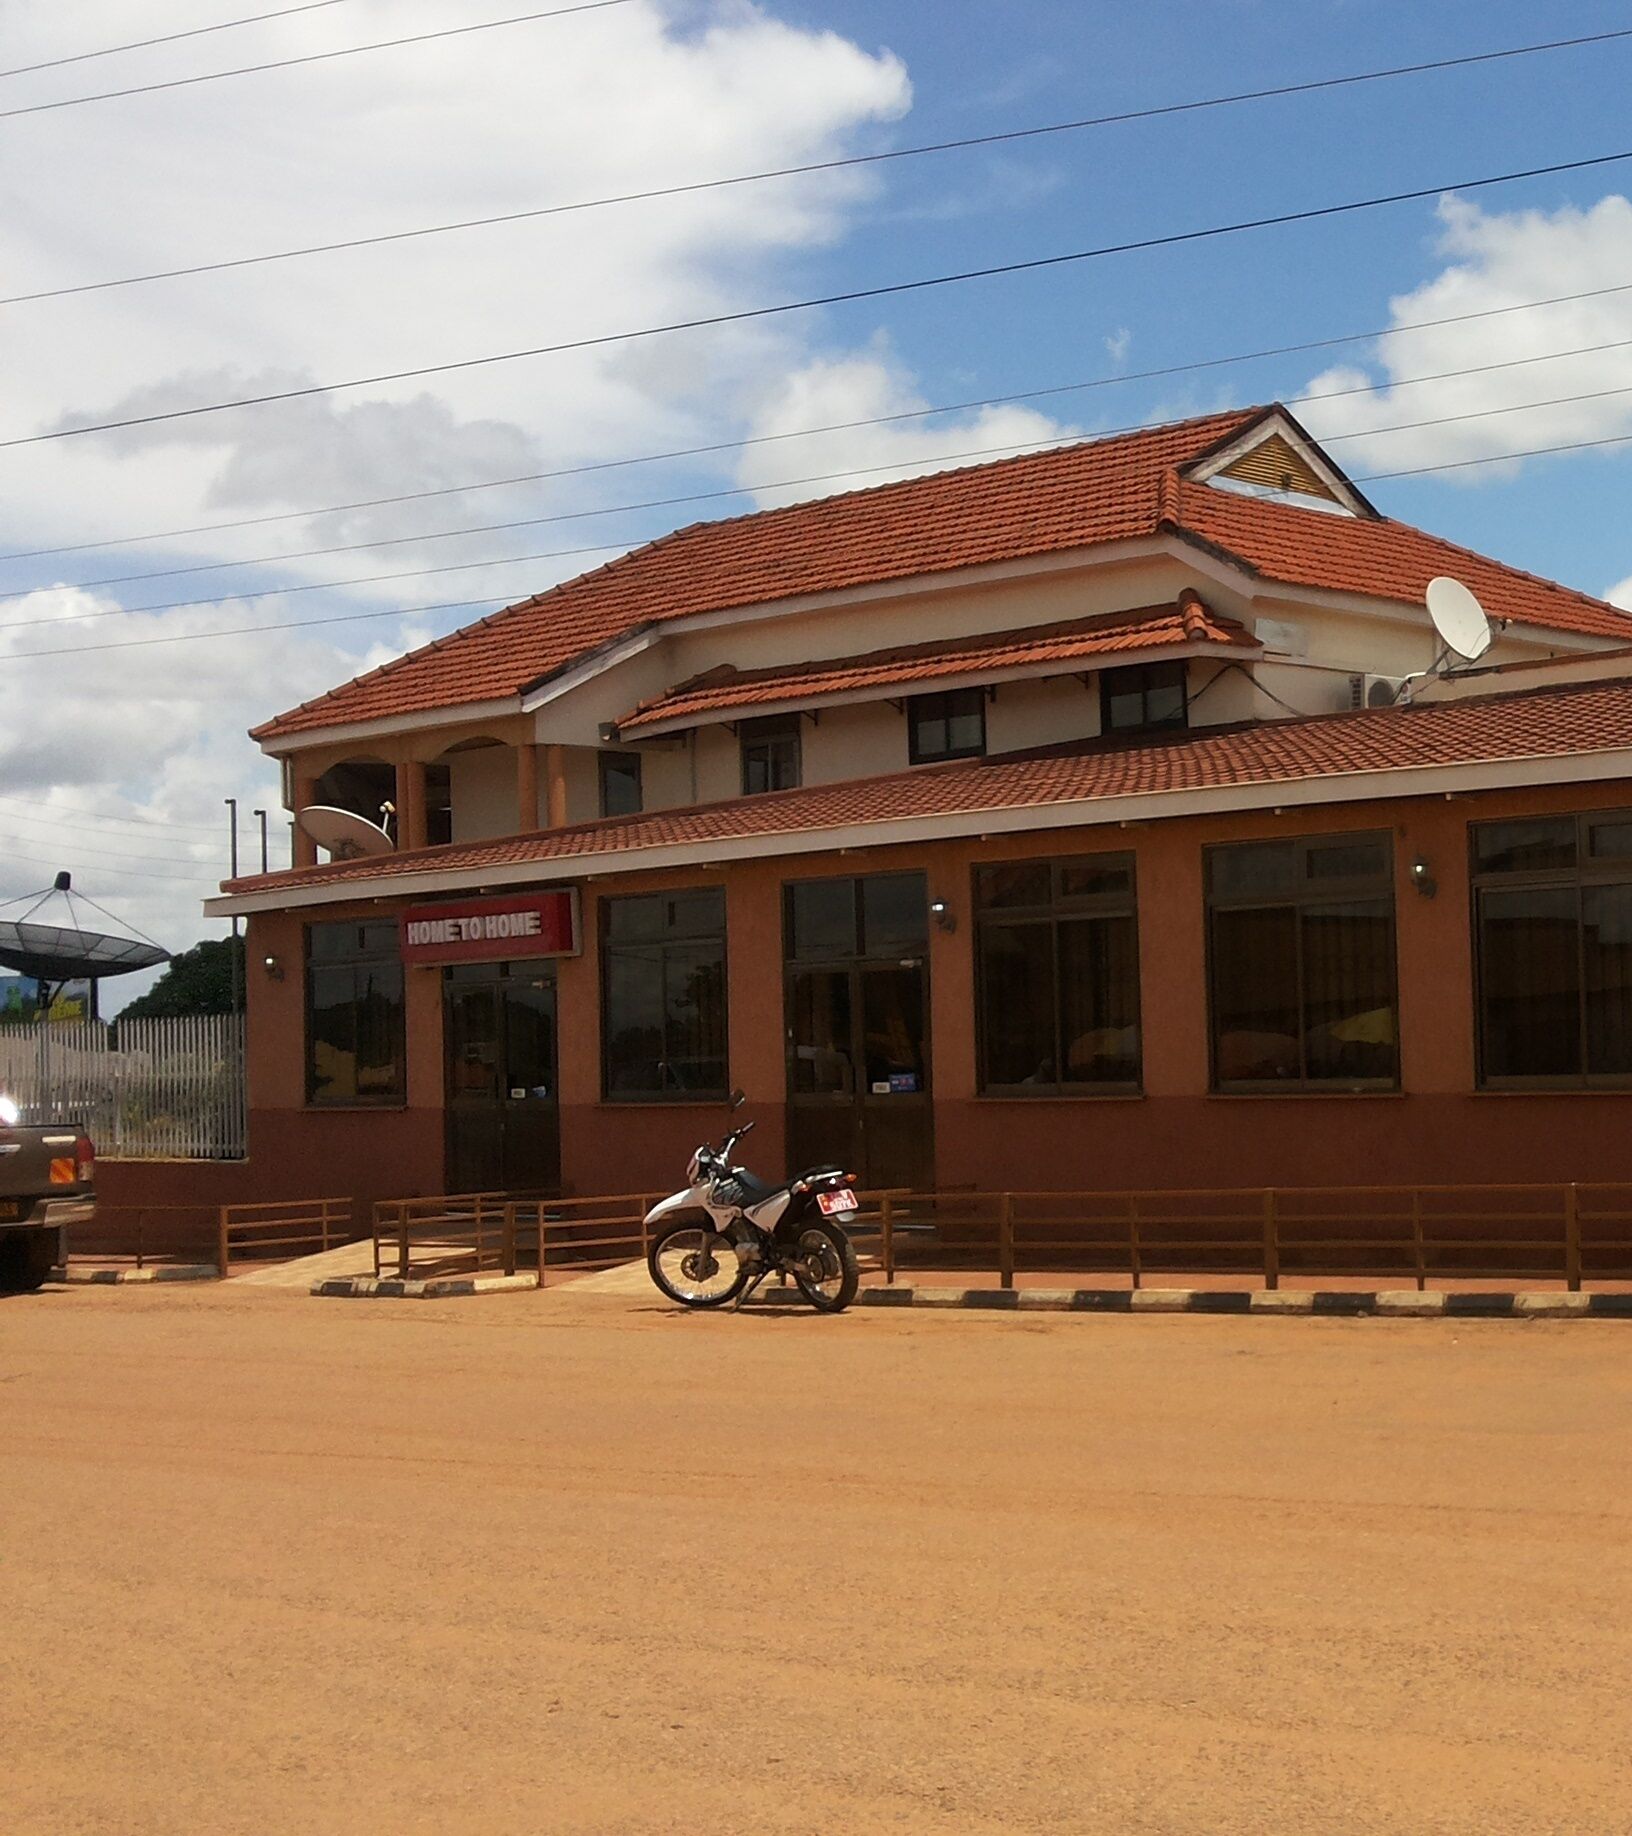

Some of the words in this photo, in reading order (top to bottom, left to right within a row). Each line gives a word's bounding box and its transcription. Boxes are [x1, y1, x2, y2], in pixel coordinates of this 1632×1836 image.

[407, 918, 460, 945] HOME
[460, 916, 483, 941] TO
[485, 911, 542, 939] HOME
